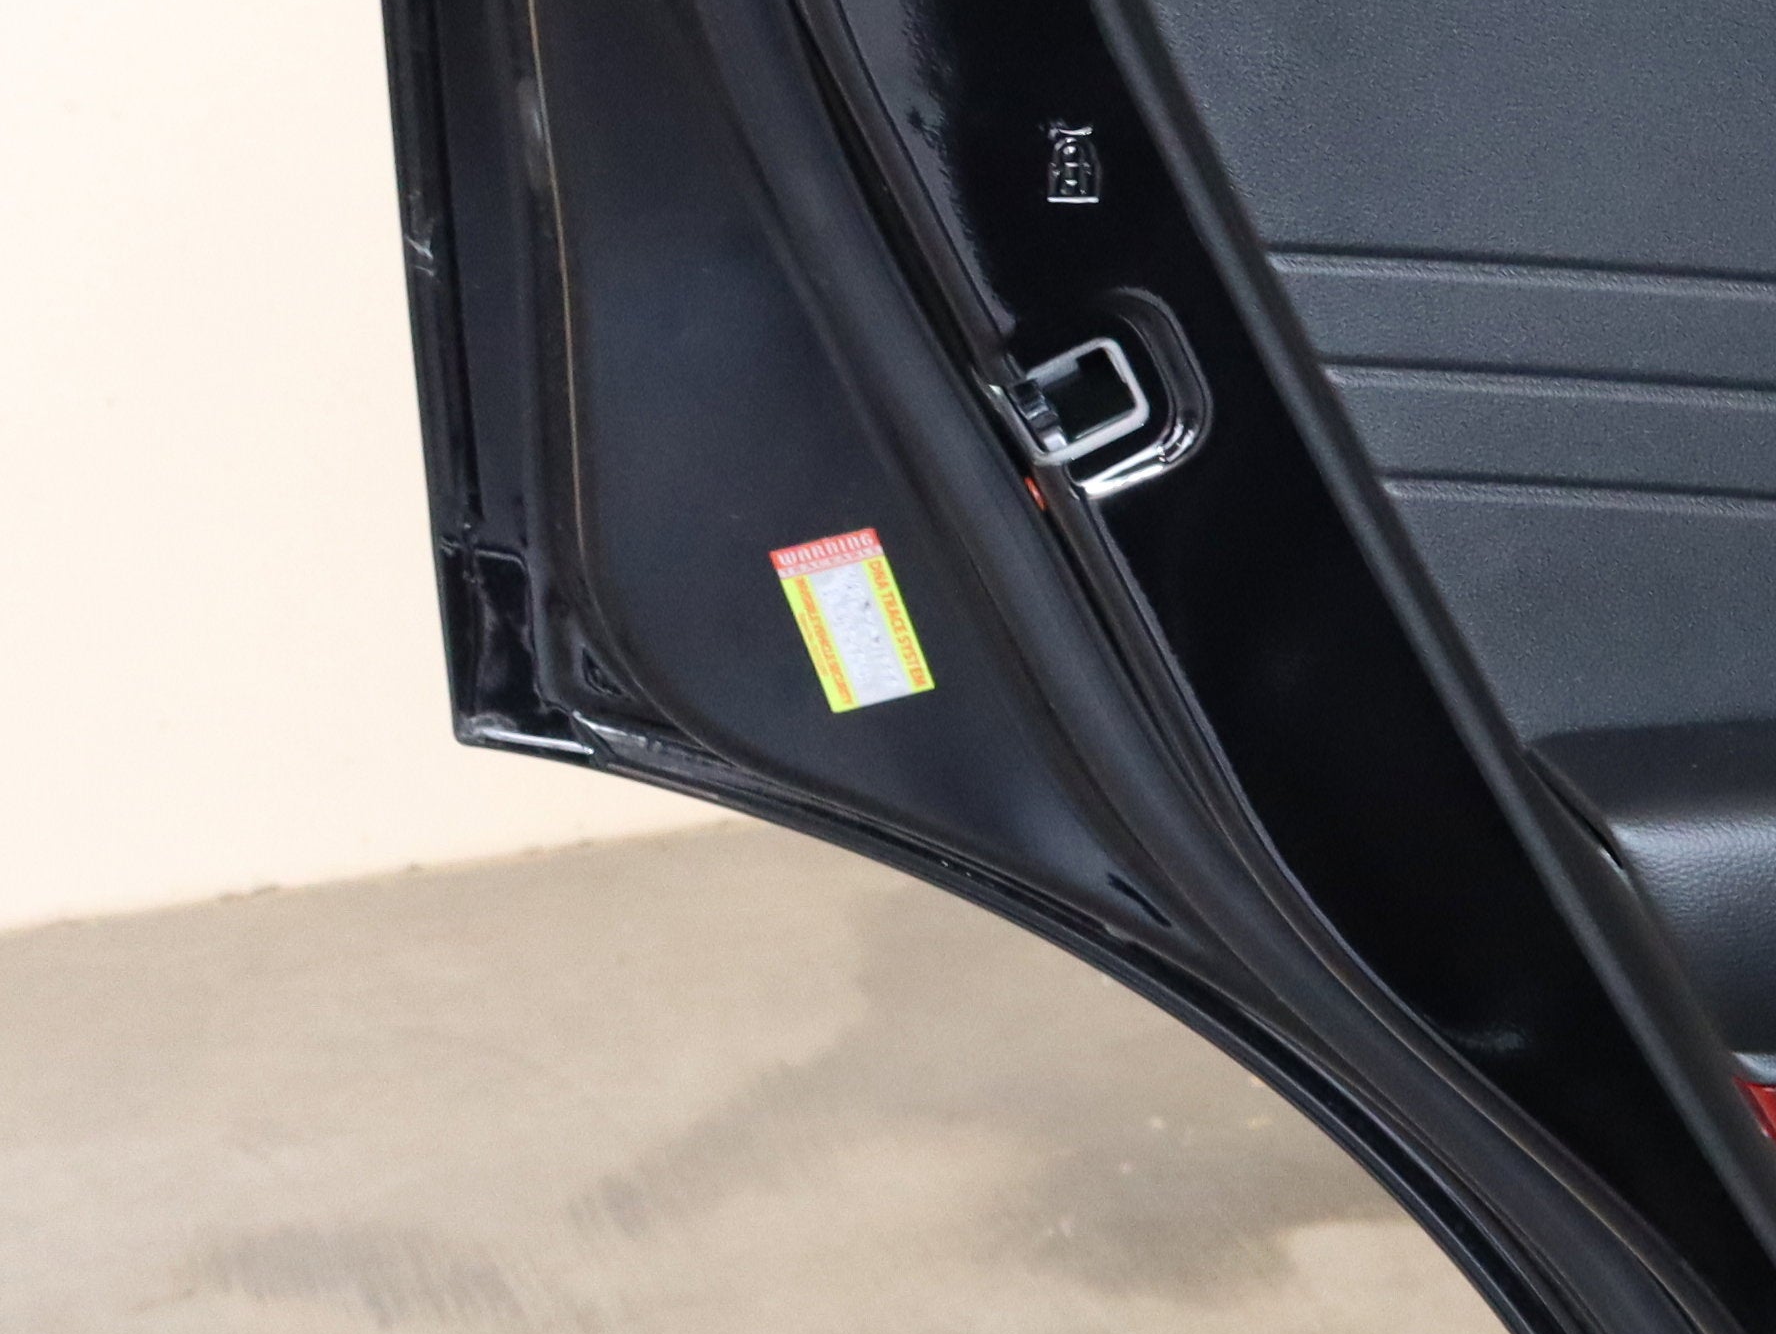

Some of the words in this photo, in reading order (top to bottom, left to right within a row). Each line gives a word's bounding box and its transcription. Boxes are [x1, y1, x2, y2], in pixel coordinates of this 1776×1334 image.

[777, 533, 873, 566] WARNING
[868, 560, 890, 590] DNA
[879, 590, 907, 635] TRACE
[896, 634, 927, 688] SYSTEM
